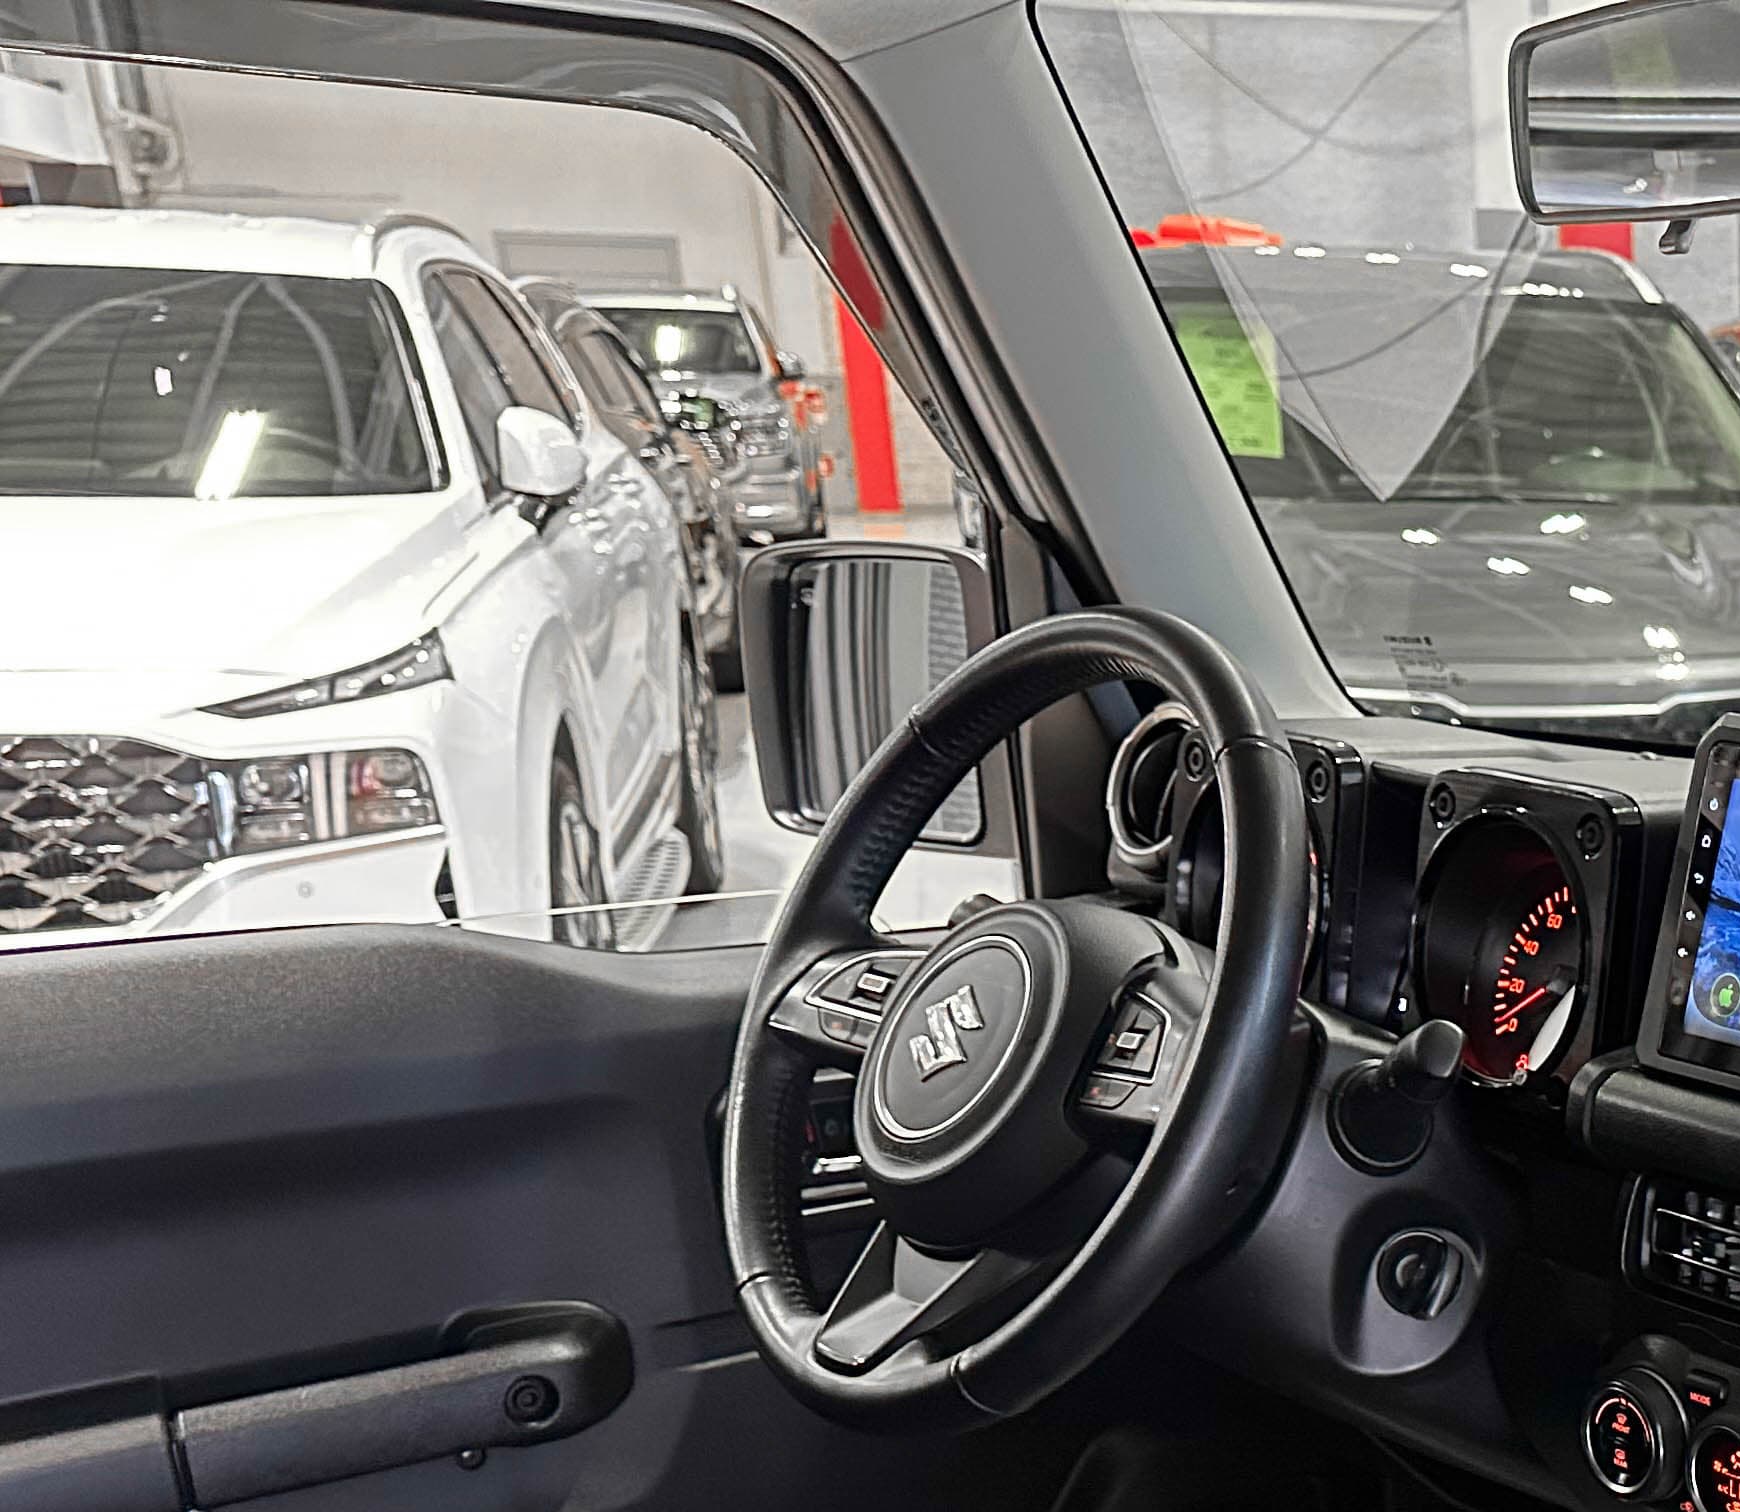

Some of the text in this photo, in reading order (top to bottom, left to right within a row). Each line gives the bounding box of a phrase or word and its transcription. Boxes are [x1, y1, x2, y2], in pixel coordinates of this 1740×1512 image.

[1547, 914, 1562, 929] 60
[1524, 940, 1540, 956] 40
[1509, 978, 1525, 994] 20
[1689, 1391, 1711, 1407] MODE
